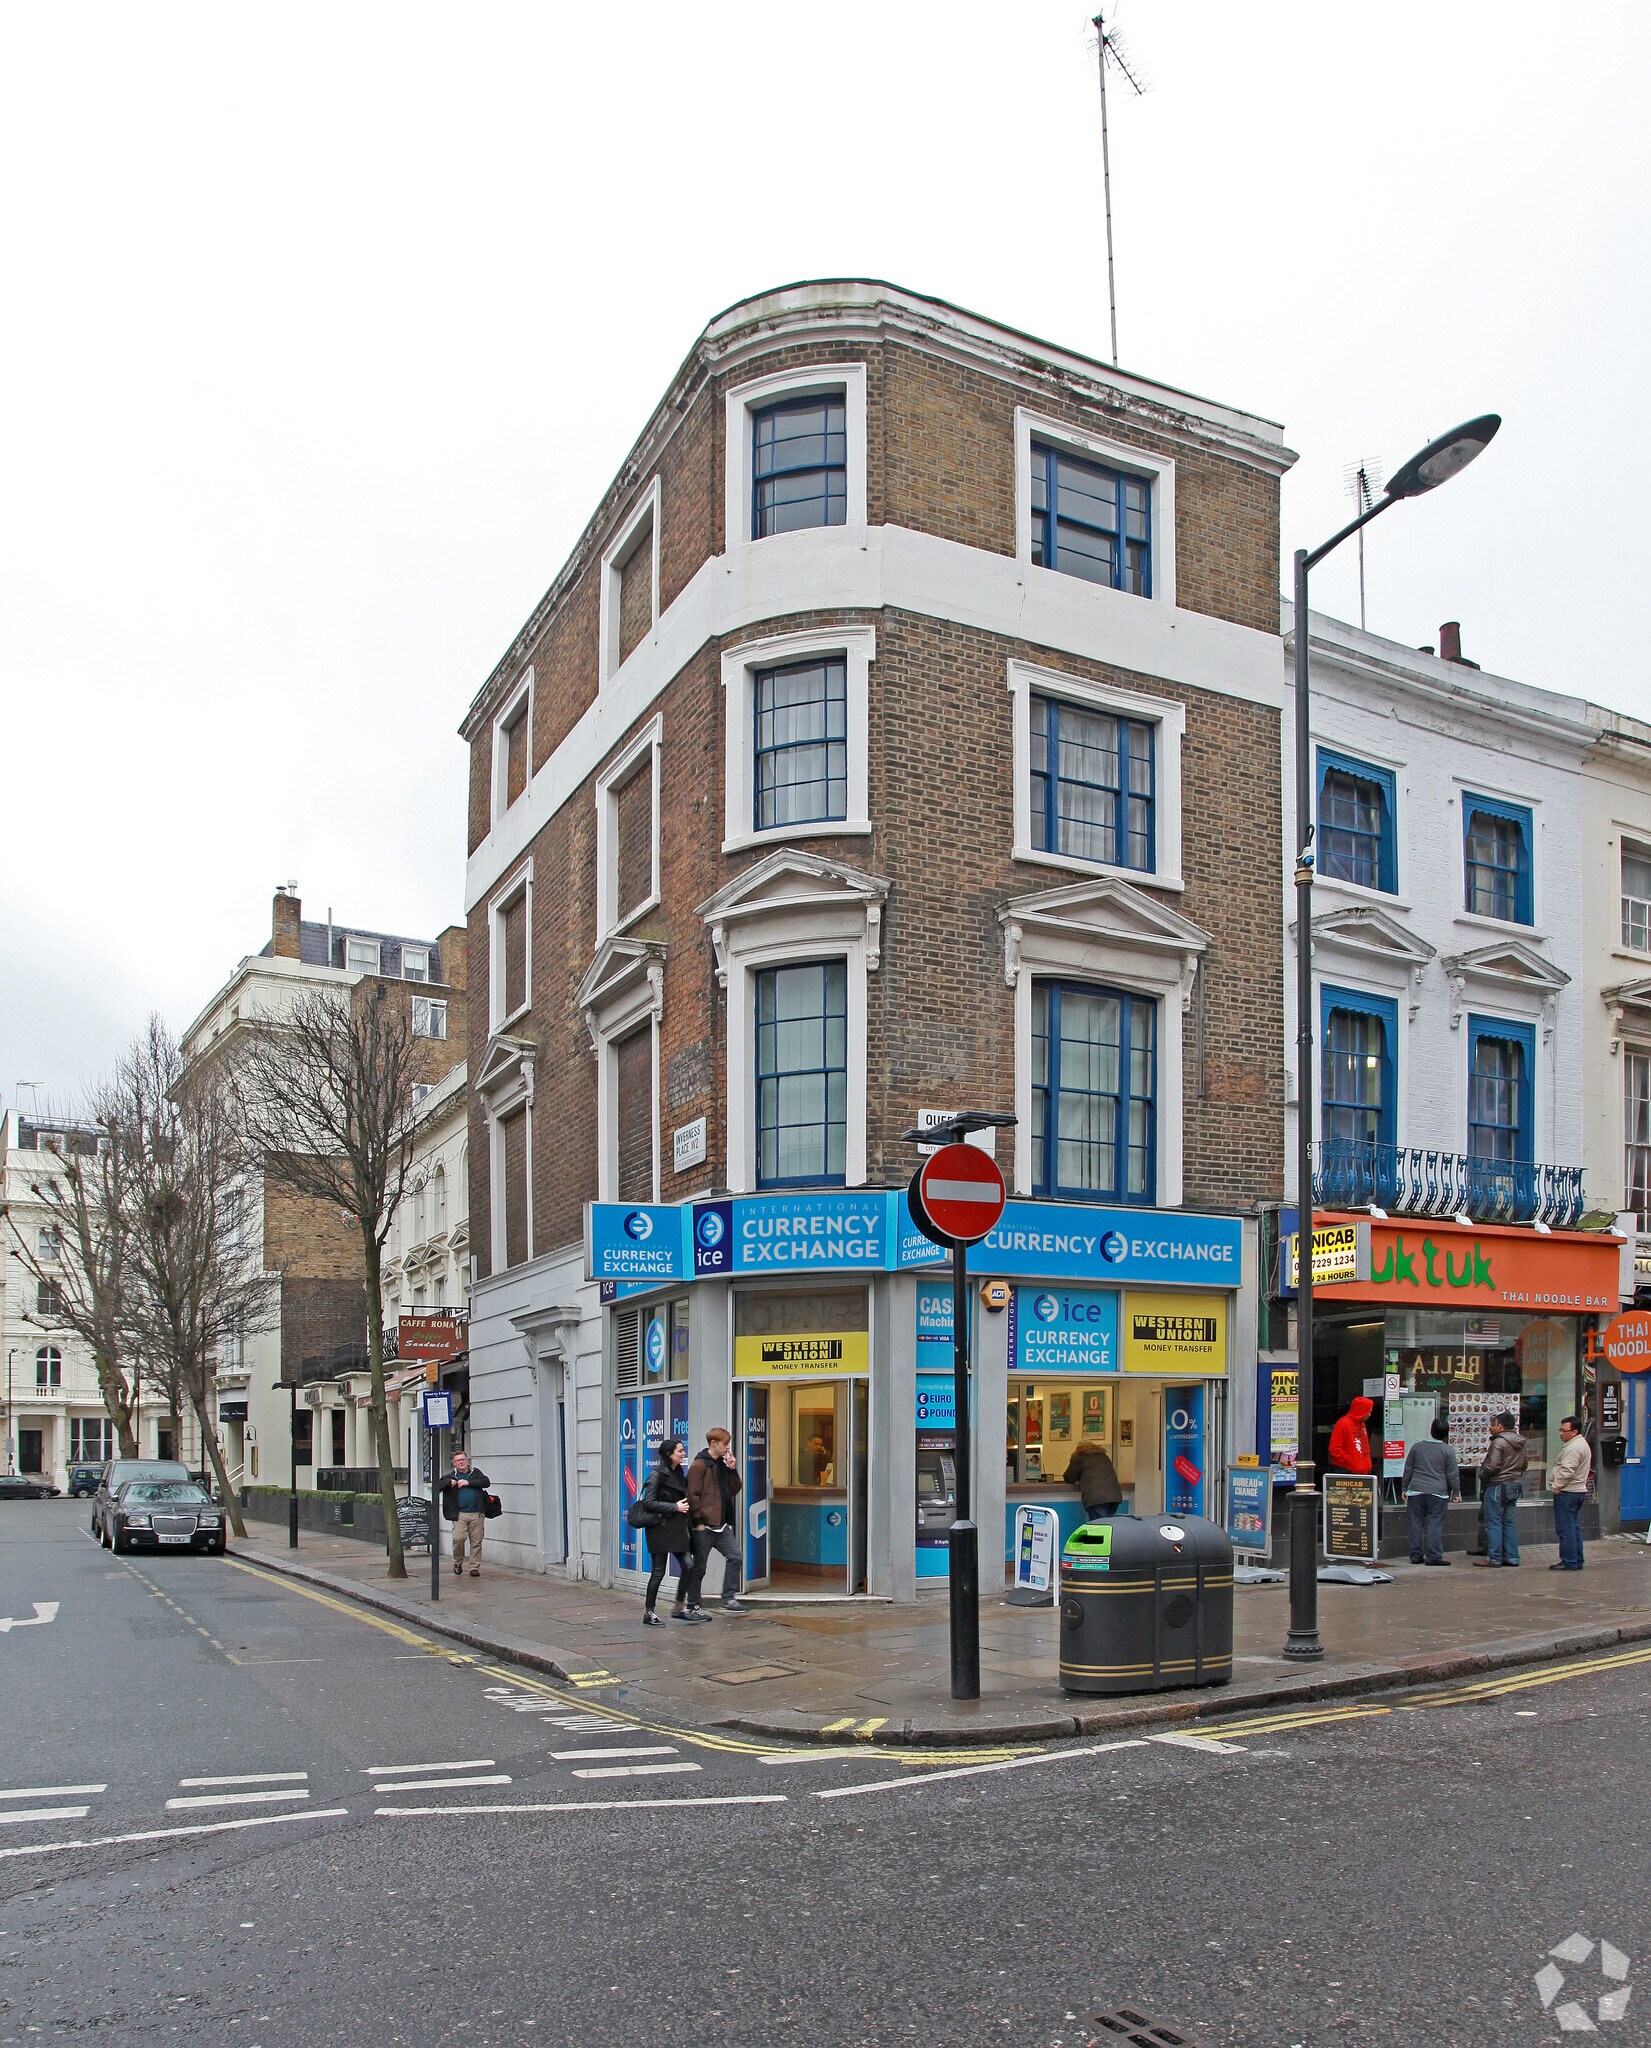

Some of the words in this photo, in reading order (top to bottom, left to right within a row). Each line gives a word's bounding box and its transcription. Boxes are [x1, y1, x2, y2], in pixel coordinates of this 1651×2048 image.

[742, 1203, 879, 1216] INTERNATIONAL
[743, 1216, 879, 1239] CURRENCY
[984, 1230, 1097, 1254] CURRENCY
[1131, 1240, 1233, 1262] EXCHANGE
[1294, 1229, 1354, 1252] NICAB
[603, 1249, 673, 1261] CURRENCY
[697, 1248, 723, 1266] ice
[743, 1239, 879, 1262] EXCHANGE
[902, 1245, 940, 1261] EXCHANGE
[603, 1261, 673, 1273] EXCHANGE
[1312, 1258, 1332, 1269] 7229
[1334, 1254, 1354, 1266] 1234
[1328, 1271, 1354, 1280] HOURS
[992, 1290, 1005, 1298] ADT
[1502, 1291, 1528, 1302] THAI
[1535, 1293, 1580, 1305] NOODLE
[1586, 1295, 1608, 1306] BAR
[920, 1297, 953, 1315] CAS
[1063, 1297, 1101, 1323] ice
[401, 1319, 426, 1328] CAFFE
[431, 1320, 454, 1328] ROMA
[920, 1316, 954, 1327] Machin
[1135, 1316, 1203, 1329] WESTERN
[1156, 1328, 1203, 1341] UNION
[1618, 1321, 1649, 1339] THAI
[405, 1340, 450, 1348] Sandwich
[1025, 1330, 1110, 1346] CURRENCY
[763, 1341, 829, 1352] WESTERN
[1143, 1344, 1172, 1352] MONEY
[1174, 1344, 1213, 1353] TRANSFER
[1608, 1340, 1651, 1357] NOODL
[783, 1350, 829, 1360] UNION
[1025, 1349, 1110, 1364] EXCHANGE
[930, 1394, 952, 1403] EURO
[646, 1419, 664, 1435] CASH
[748, 1417, 766, 1432] CASH
[1233, 1477, 1258, 1488] BUREAU
[1335, 1480, 1364, 1488] MINICAB
[1234, 1487, 1258, 1497] CHANGE
